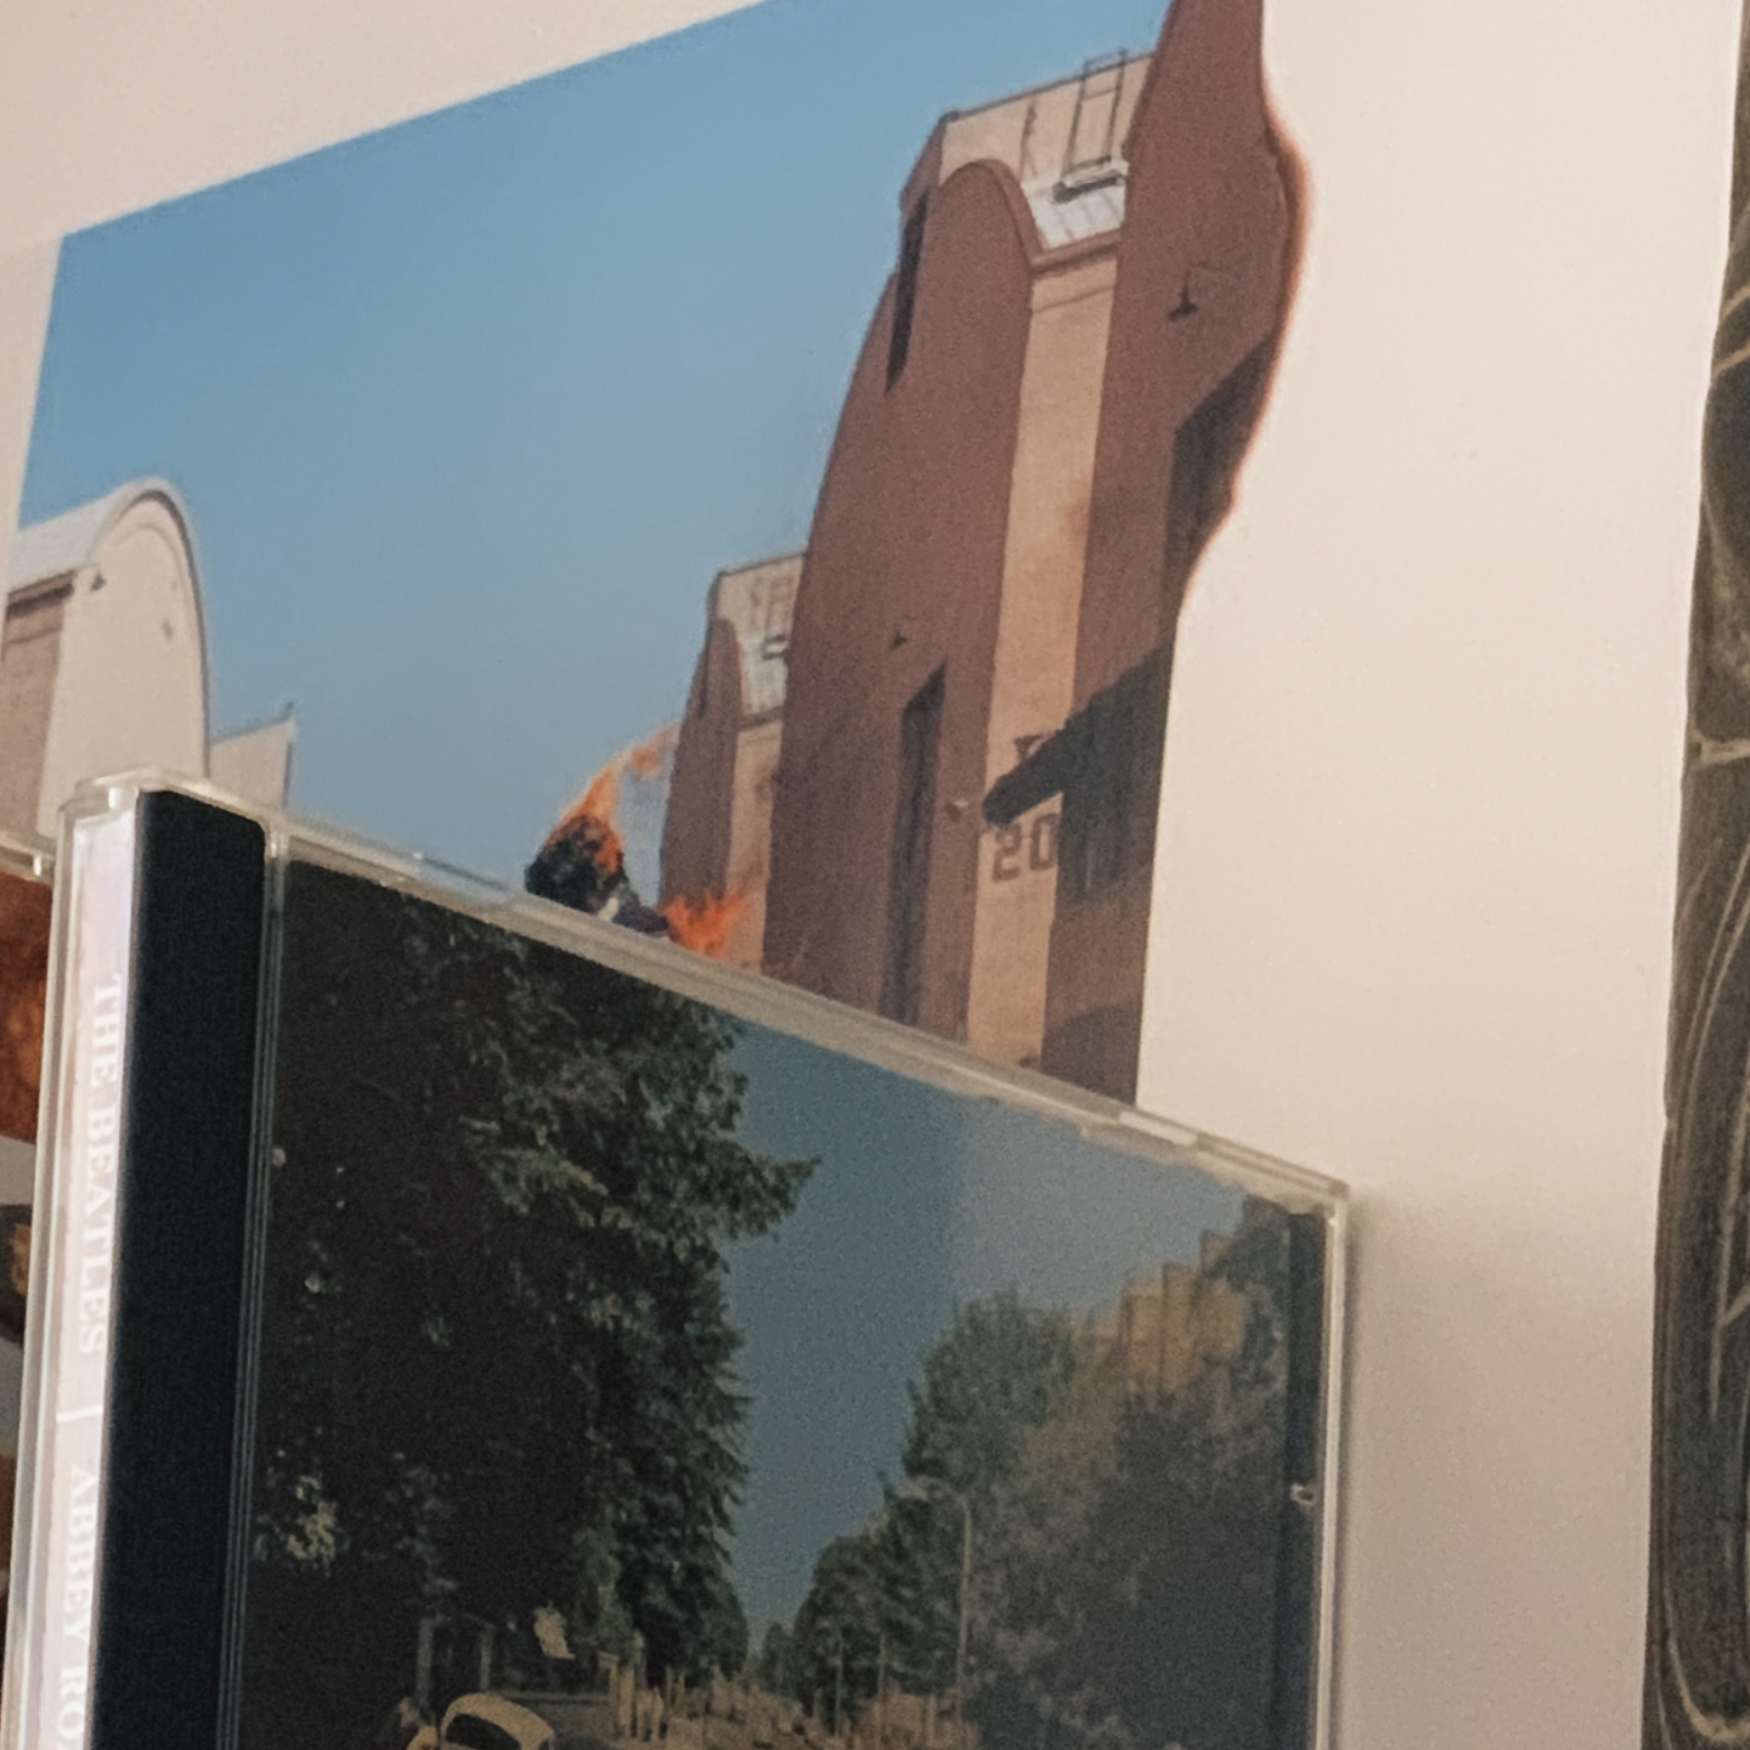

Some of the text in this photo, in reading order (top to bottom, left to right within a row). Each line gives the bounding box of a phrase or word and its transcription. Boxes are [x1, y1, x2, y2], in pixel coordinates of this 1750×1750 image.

[992, 815, 1056, 880] 20
[89, 973, 121, 1088] THE
[77, 1106, 116, 1355] BEATLES
[63, 1465, 98, 1645] ABBEY
